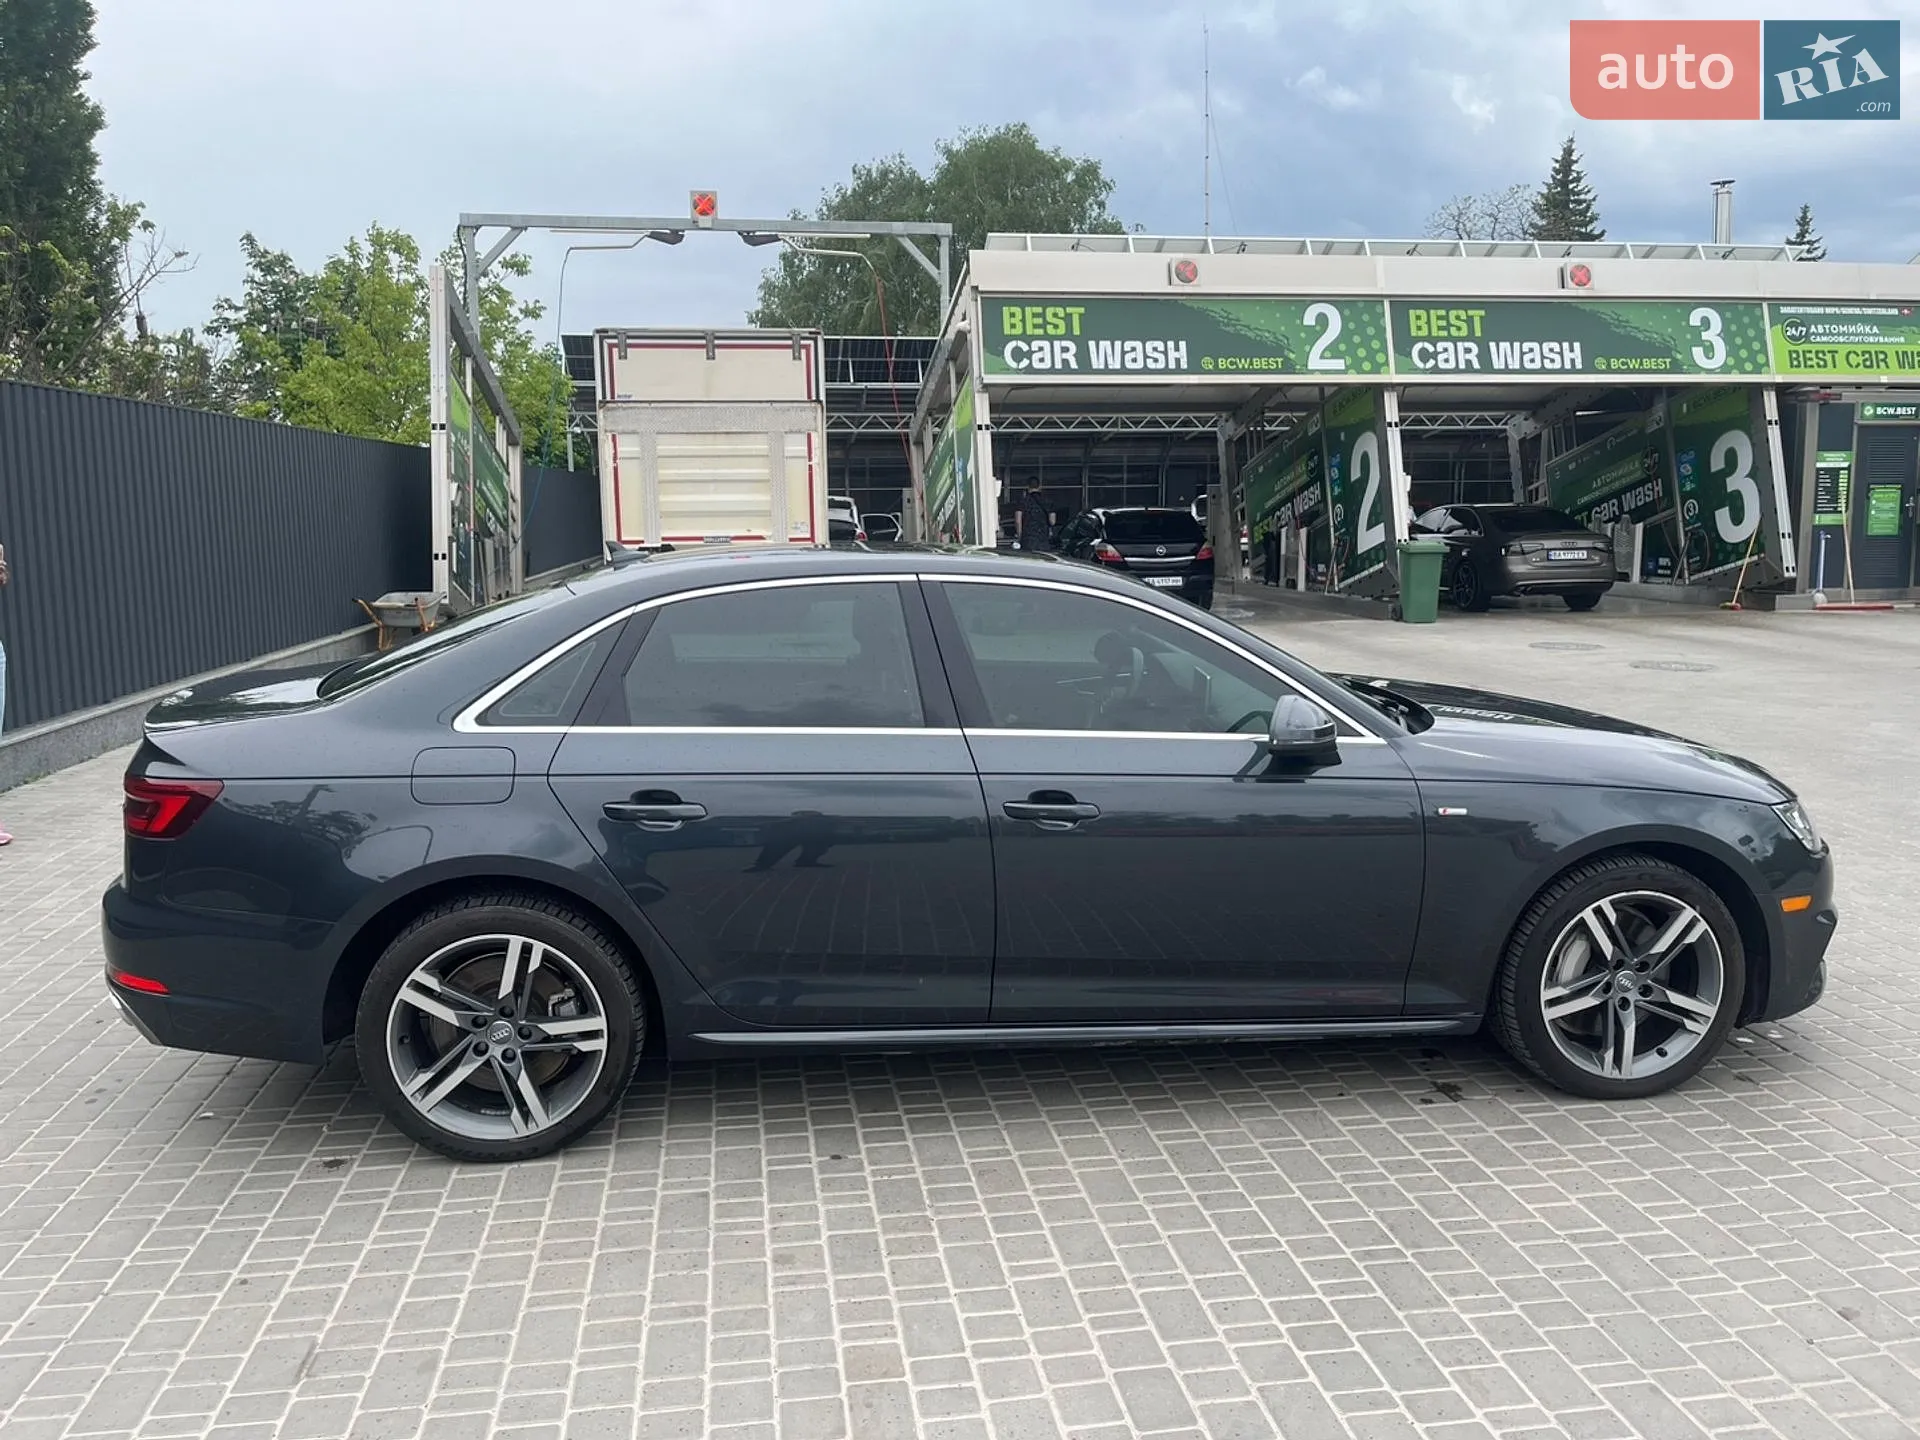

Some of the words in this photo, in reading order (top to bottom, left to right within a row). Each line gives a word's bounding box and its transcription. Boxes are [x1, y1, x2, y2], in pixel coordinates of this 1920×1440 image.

[1002, 306, 1085, 335] BEST
[1408, 308, 1486, 337] BEST
[1809, 323, 1880, 334] АВТОМИЙКА
[1302, 302, 1346, 370] 2
[1688, 307, 1727, 369] 3
[1218, 357, 1284, 369] BCW.BEST
[1609, 357, 1672, 369] BCW.BEST
[1788, 350, 1839, 369] BEST
[1351, 431, 1386, 555] 2
[1710, 429, 1762, 544] 3
